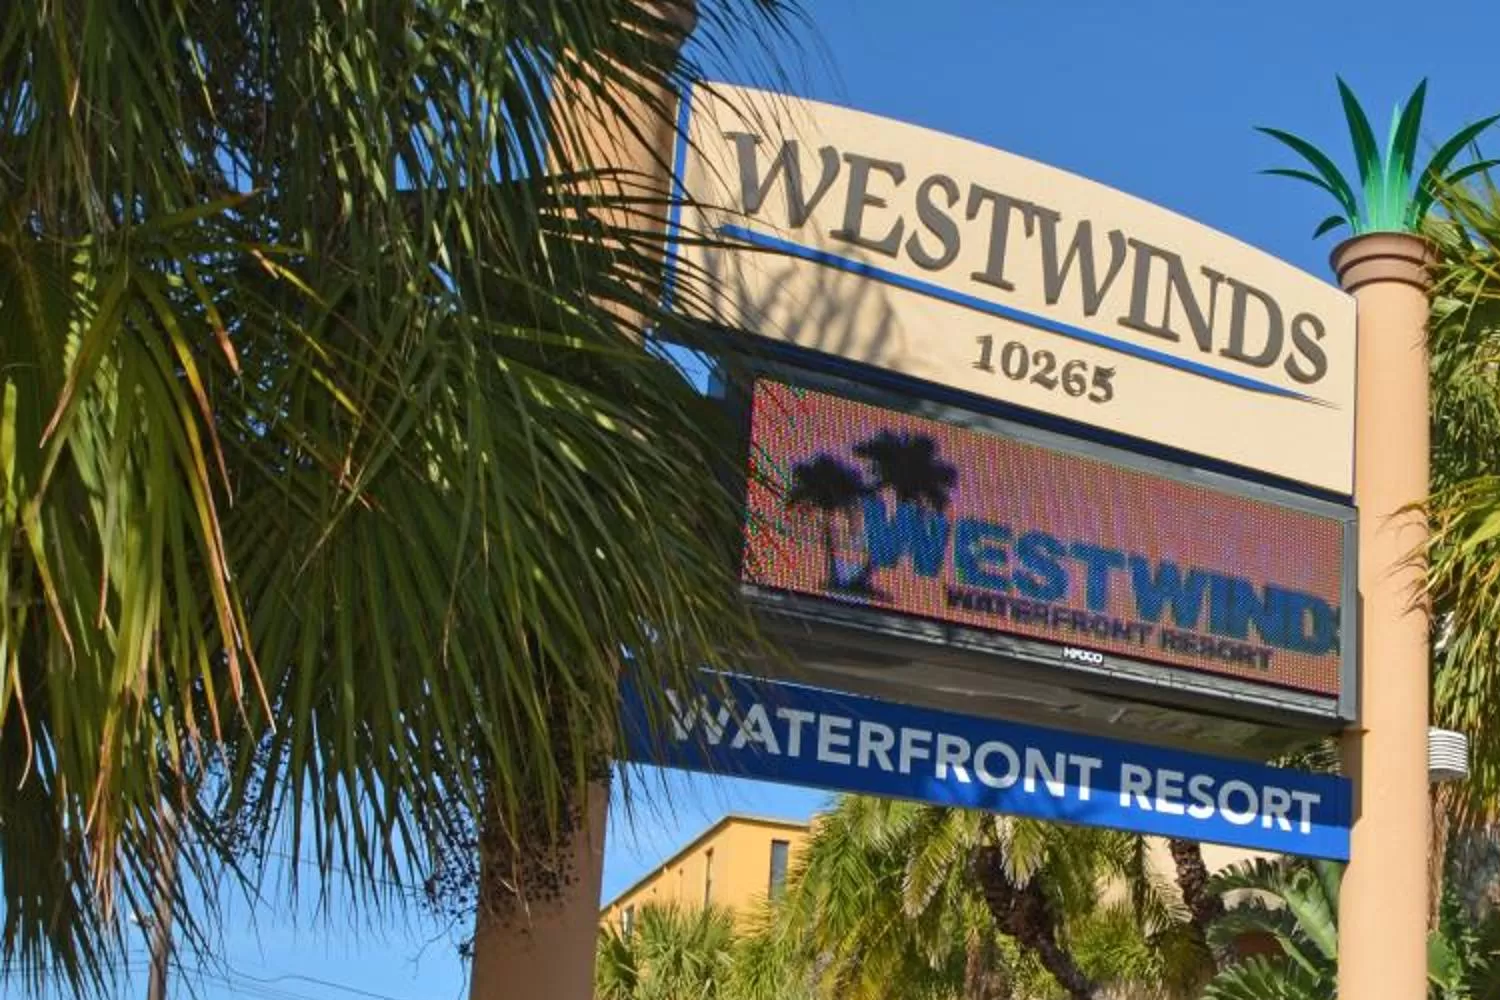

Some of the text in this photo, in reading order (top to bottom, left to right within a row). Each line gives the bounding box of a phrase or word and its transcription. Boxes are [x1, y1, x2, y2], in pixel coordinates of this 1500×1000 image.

[724, 131, 1328, 384] WESTWINDS
[972, 334, 1117, 404] 10265
[862, 497, 1341, 656] WESTWIND
[948, 584, 1272, 671] WATERFRONT RESORT
[664, 688, 1320, 834] WATERFRONT RESORT
